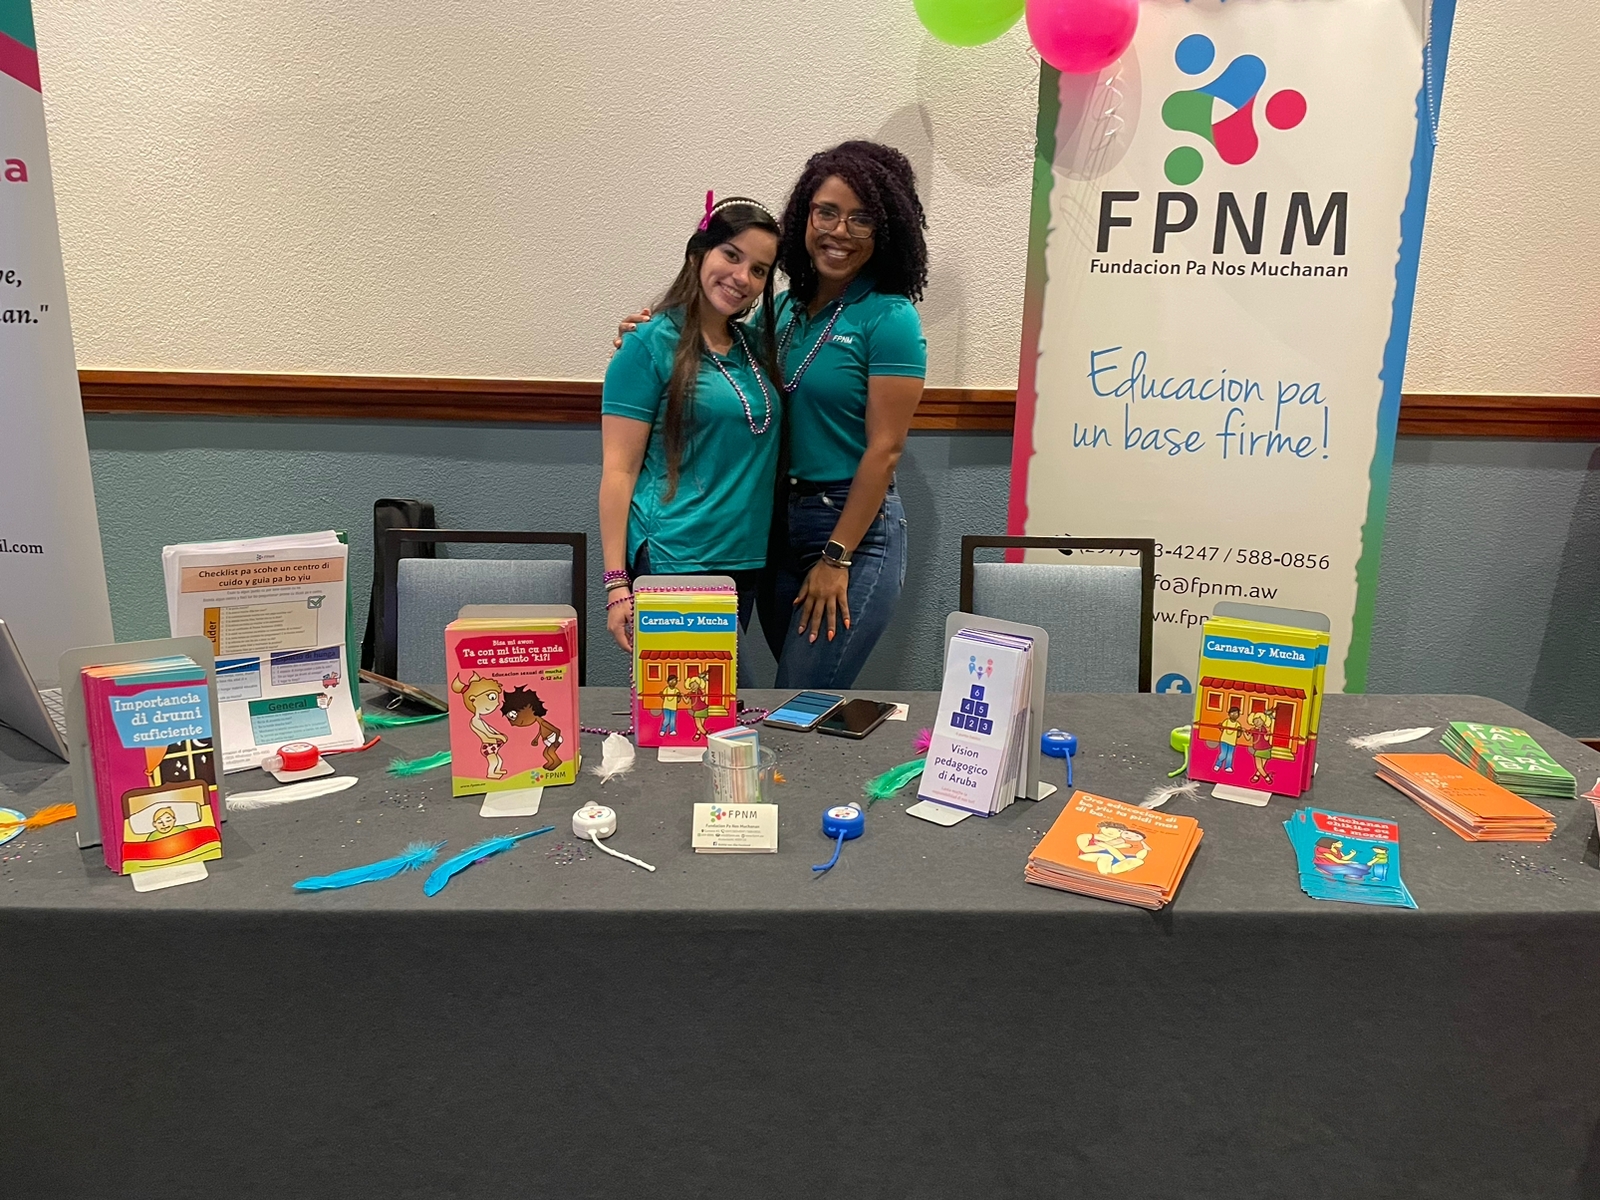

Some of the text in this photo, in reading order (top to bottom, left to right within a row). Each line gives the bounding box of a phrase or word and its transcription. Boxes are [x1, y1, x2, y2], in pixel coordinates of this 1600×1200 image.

[0, 157, 29, 183] a
[1096, 190, 1348, 256] FPNM
[1090, 259, 1348, 278] Fundacion Pa Nos Muchanan
[0, 304, 50, 325] an."
[833, 334, 853, 344] FPNM
[1086, 346, 1327, 431] Educacion pa
[1073, 402, 1329, 460] un base firme!
[1223, 548, 1233, 563] /
[1236, 548, 1331, 570] 588-0856
[198, 567, 239, 578] Checklist
[240, 569, 252, 577] pa
[253, 565, 278, 574] scohe
[293, 563, 320, 571] centro
[321, 561, 330, 569] di
[218, 578, 243, 587] cuido
[252, 576, 270, 586] guia
[272, 576, 283, 584] pa
[285, 574, 296, 582] bo
[298, 573, 311, 582] yiu
[641, 614, 728, 627] Carnaval y Mucha
[463, 648, 475, 657] Ta
[497, 646, 509, 655] mi
[512, 646, 526, 655] tin
[541, 644, 564, 653] anda
[1206, 640, 1306, 662] Carnaval y Mucha
[499, 655, 529, 664] asunto
[974, 689, 980, 697] 6
[114, 692, 201, 712] Importancia
[268, 698, 308, 712] General
[964, 703, 984, 714] 4 5
[131, 708, 203, 726] di drumi
[968, 719, 974, 728] 2
[982, 723, 988, 731] 3
[133, 725, 203, 742] suficiente
[951, 743, 979, 759] Vision
[934, 756, 988, 776] pedagogico
[545, 771, 566, 780] FPNM
[938, 770, 977, 788] di Aruba
[728, 809, 758, 819] FPNM
[1075, 805, 1086, 813] di
[1079, 800, 1093, 808] bo
[1095, 806, 1113, 814] yiu
[1129, 814, 1152, 824] pidi
[1154, 821, 1179, 829] mas
[1082, 795, 1104, 805] Ora
[1106, 802, 1162, 821] educacion
[1326, 814, 1389, 830] Muchanan
